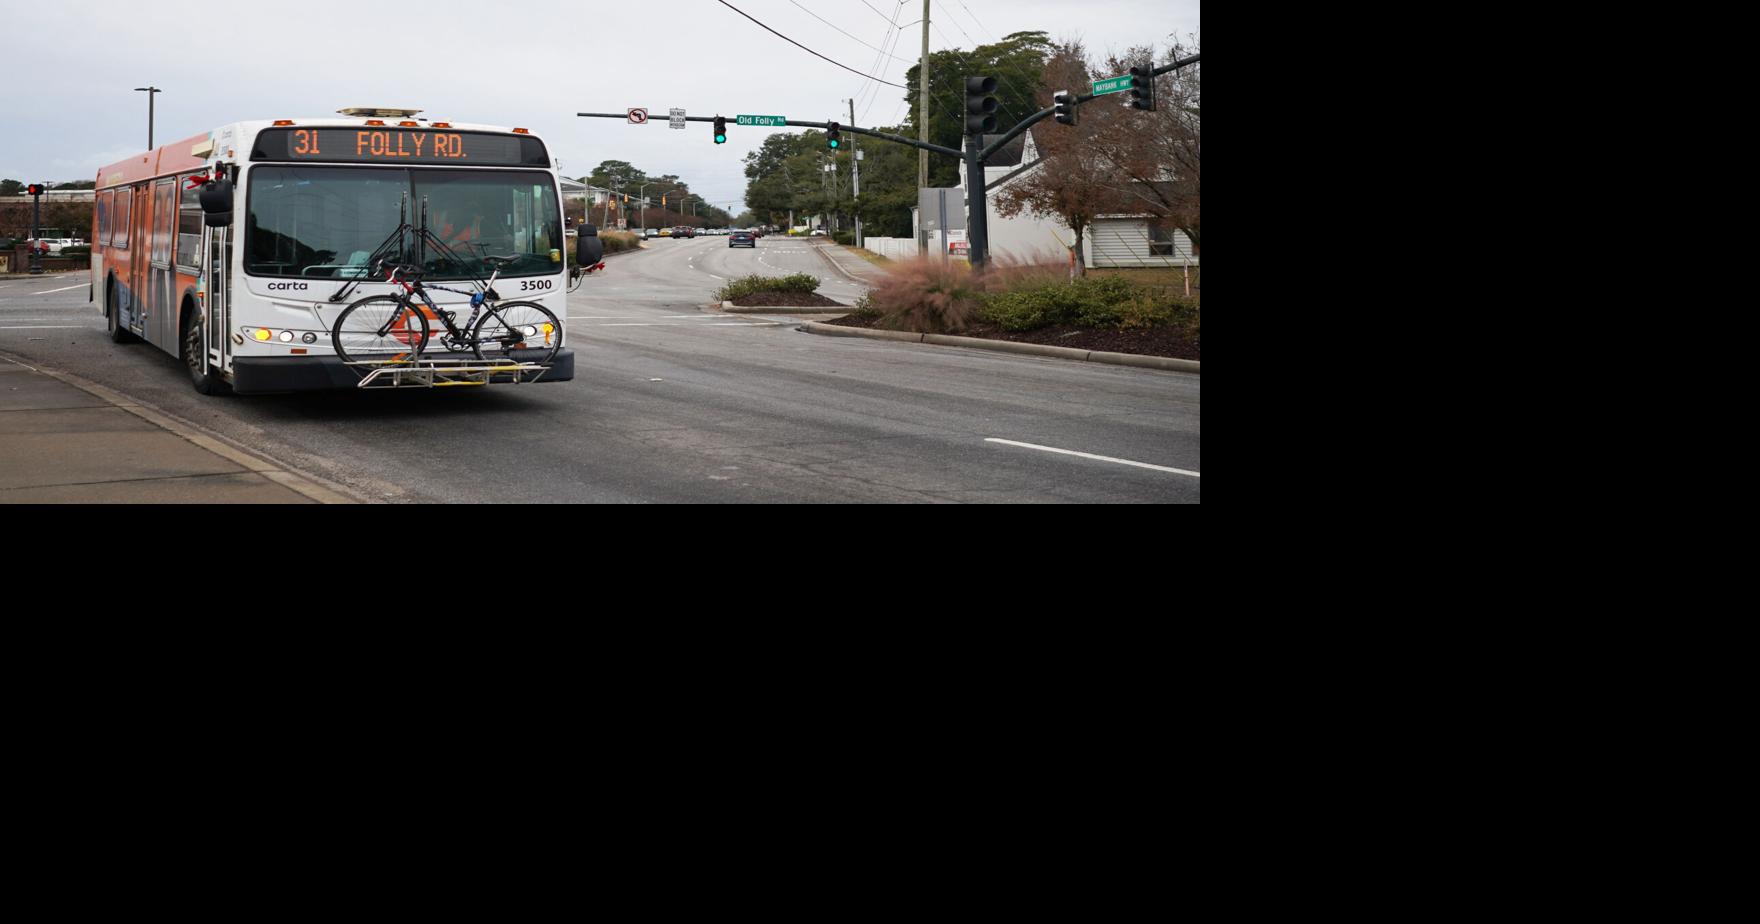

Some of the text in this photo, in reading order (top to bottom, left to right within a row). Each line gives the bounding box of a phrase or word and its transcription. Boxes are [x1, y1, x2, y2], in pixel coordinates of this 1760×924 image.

[738, 116, 752, 125] Old
[755, 116, 774, 126] Folly
[294, 129, 467, 158] 31 FOLLY RD.
[267, 281, 308, 290] carta
[520, 280, 552, 291] 3500
